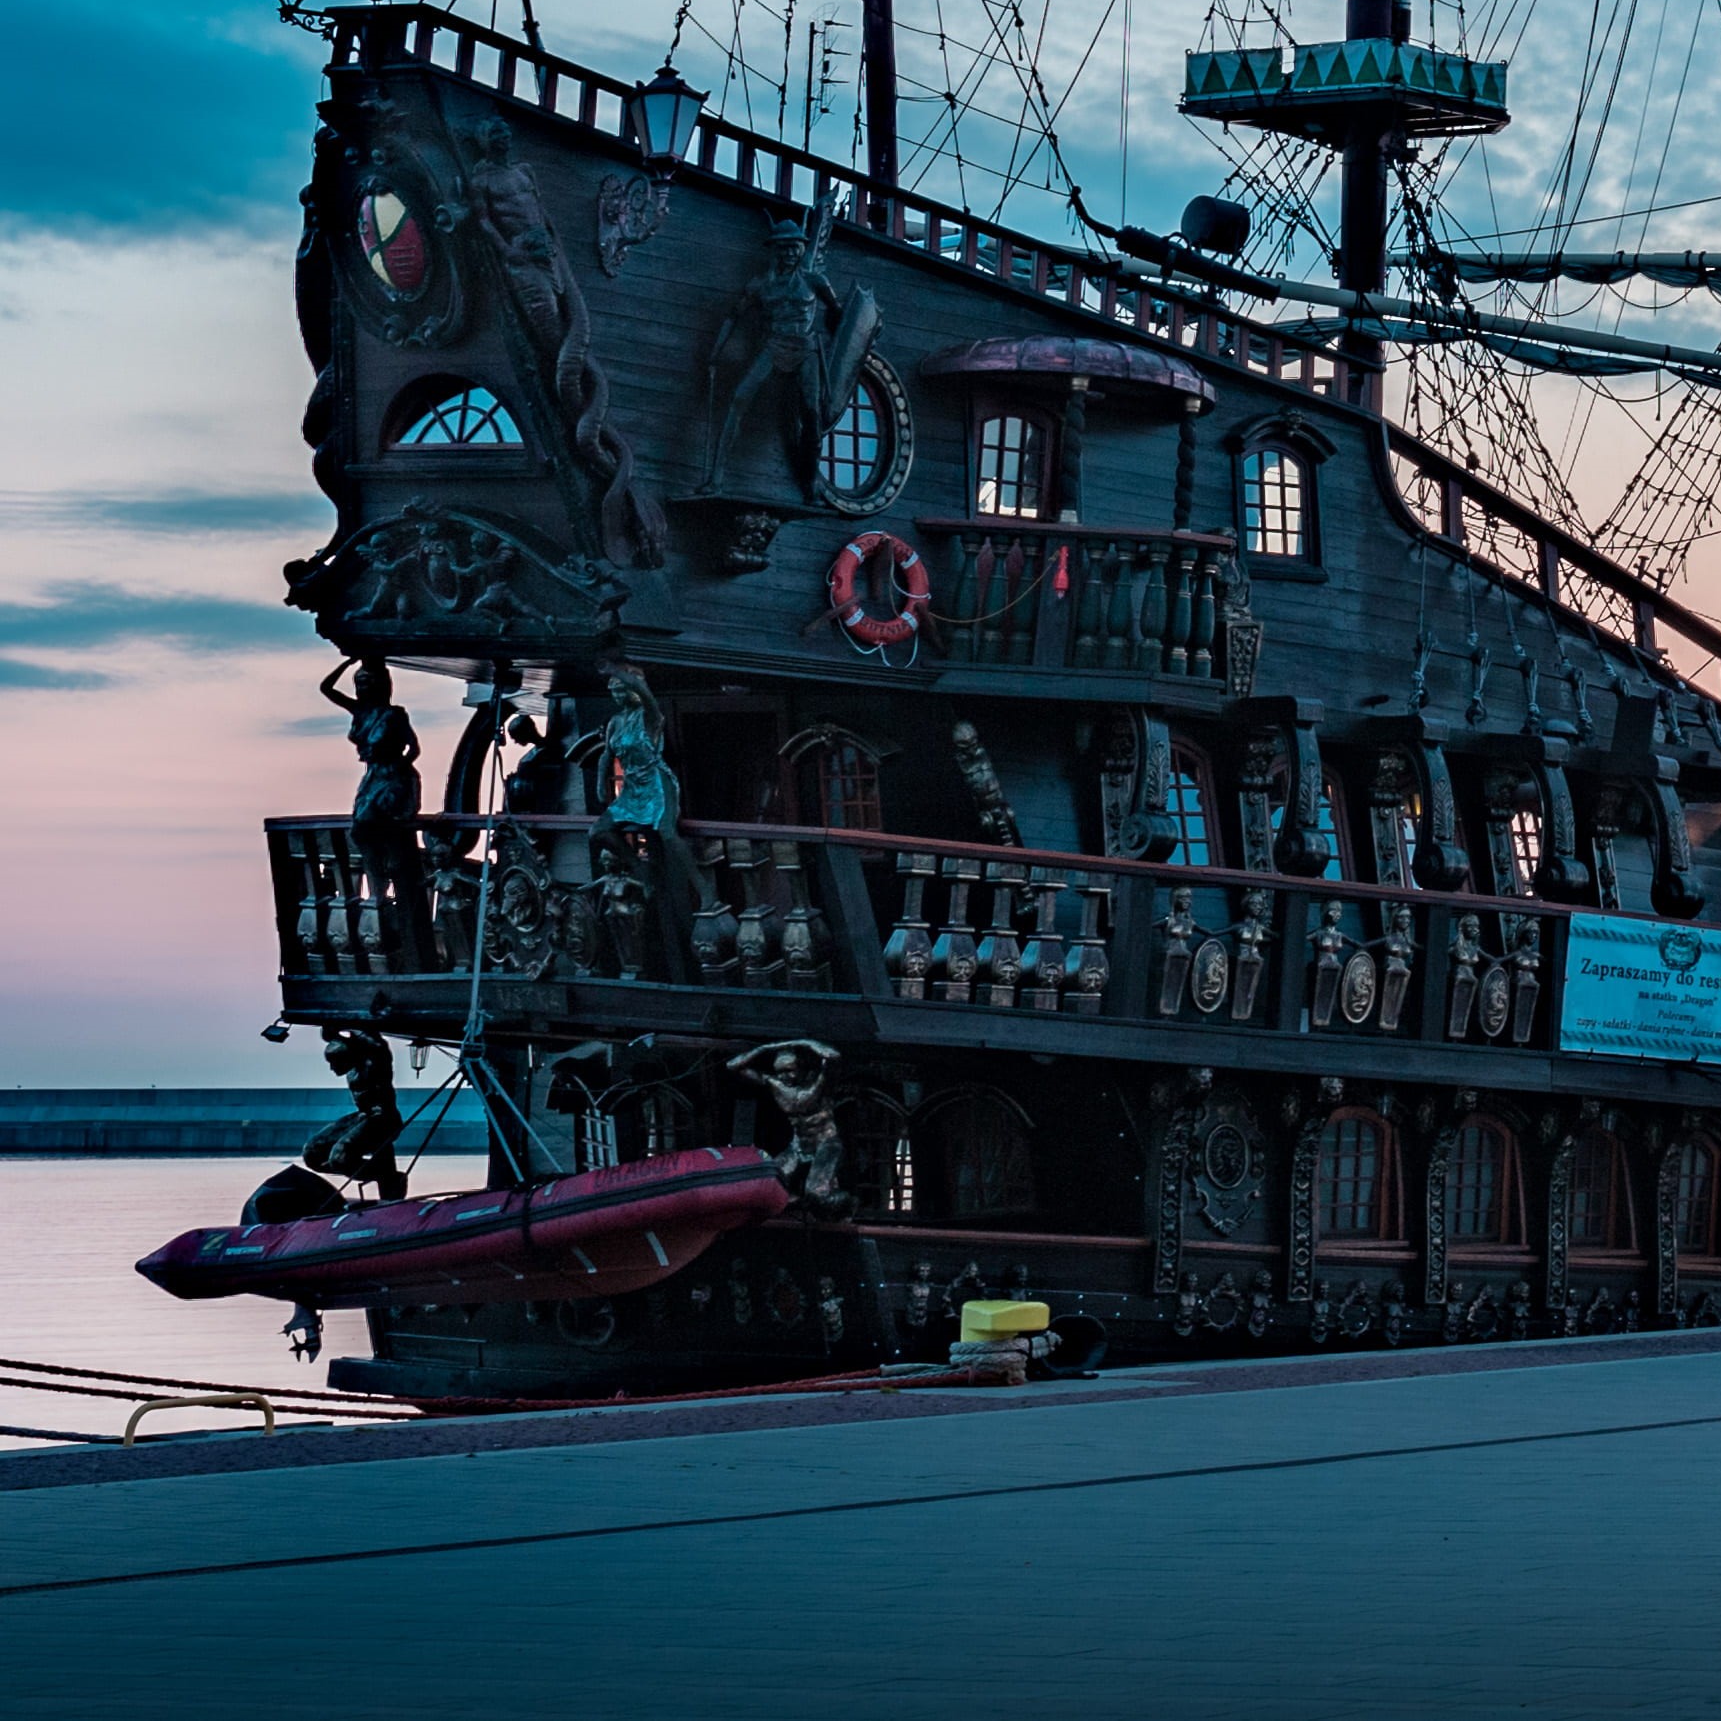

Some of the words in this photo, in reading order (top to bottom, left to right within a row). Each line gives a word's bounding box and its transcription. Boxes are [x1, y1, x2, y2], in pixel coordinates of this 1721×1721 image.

[1580, 958, 1670, 987] Zapraszamy
[1676, 970, 1694, 986] do
[1638, 991, 1649, 999] na
[1652, 992, 1678, 1002] statku
[1657, 1009, 1696, 1024] Polecamy
